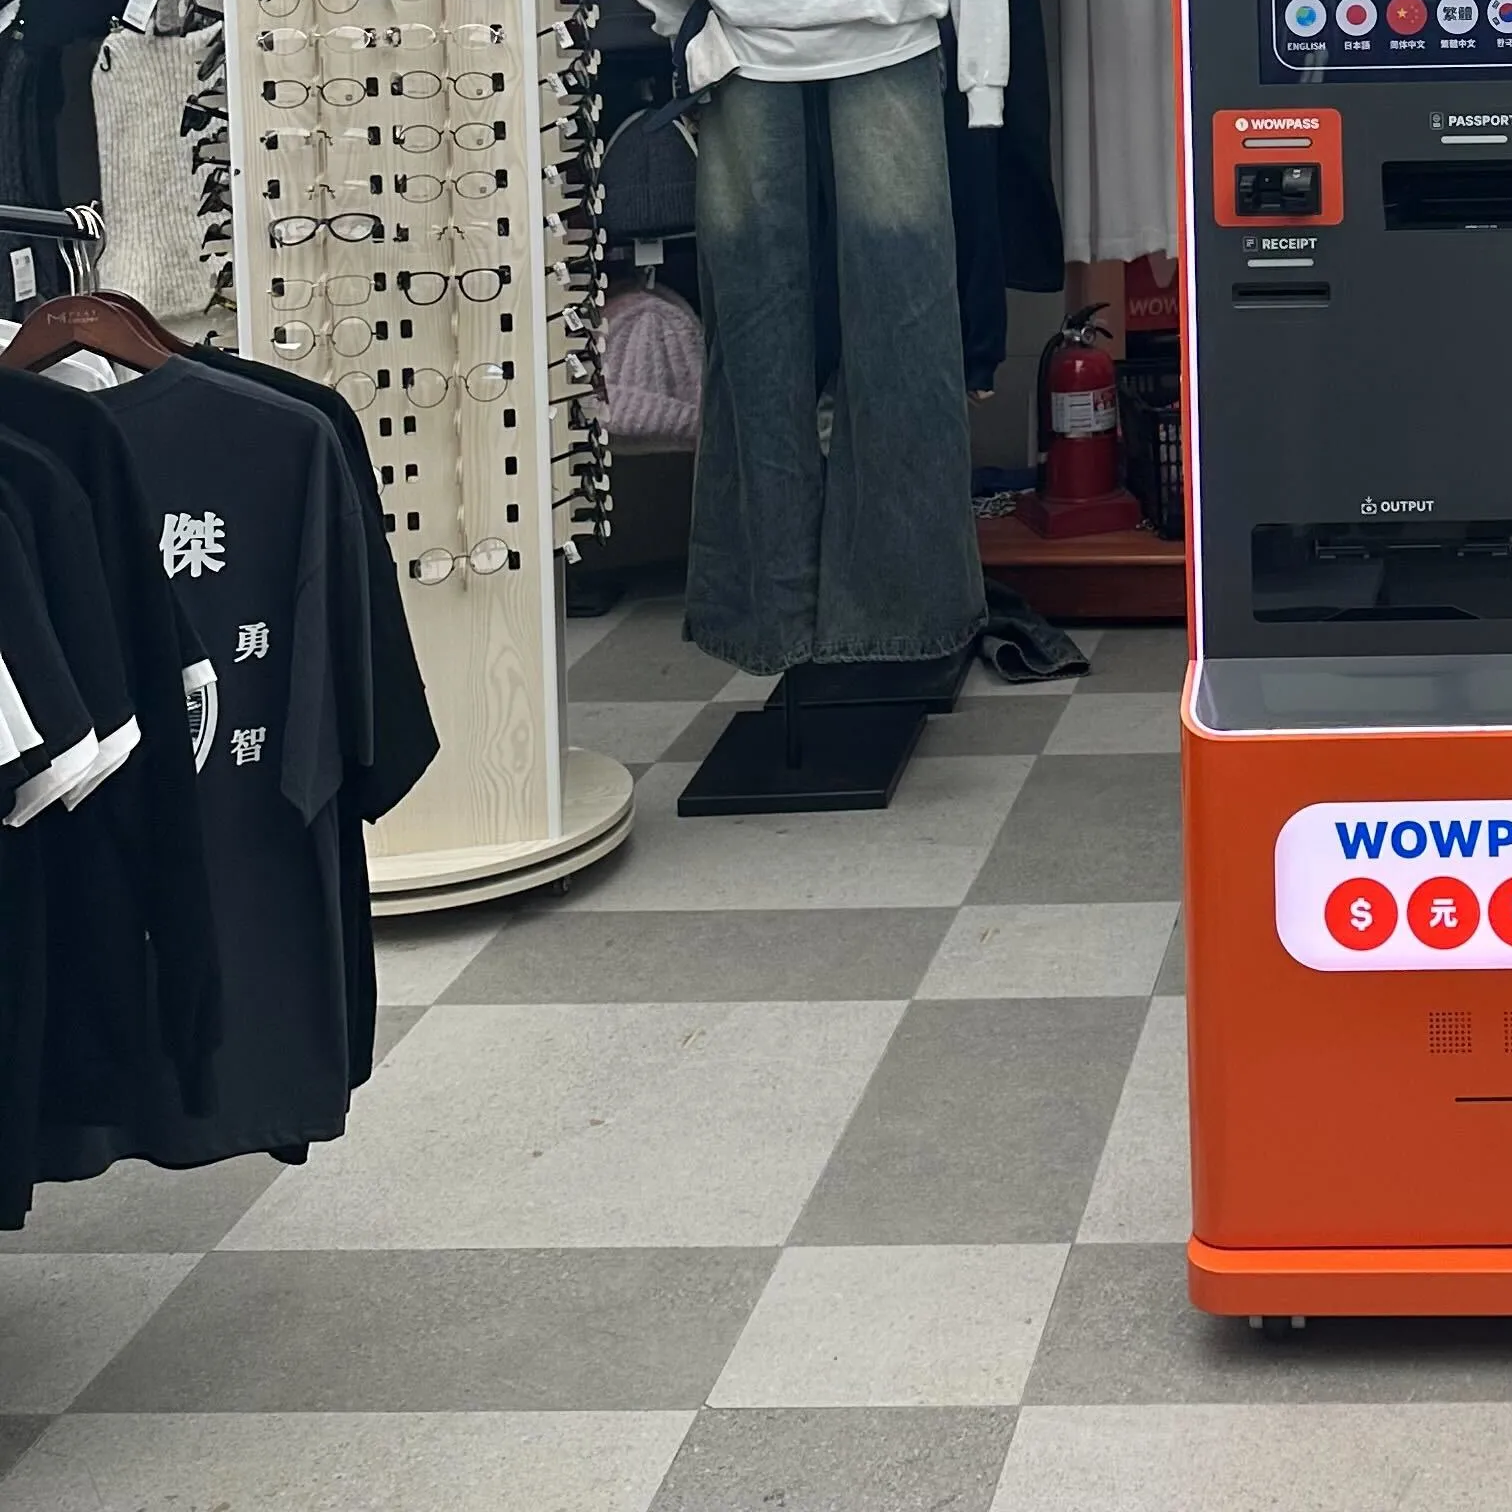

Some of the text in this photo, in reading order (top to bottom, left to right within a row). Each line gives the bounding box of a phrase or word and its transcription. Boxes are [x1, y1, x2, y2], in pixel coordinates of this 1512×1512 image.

[1287, 41, 1327, 52] ENGLISH
[1344, 40, 1371, 51] 日本語
[1250, 118, 1320, 130] WOWPASS
[1262, 238, 1318, 251] RECEIPT
[1380, 500, 1435, 513] OUTPUT
[159, 511, 226, 579] 傑
[234, 620, 270, 664] 勇
[230, 726, 267, 767] 智
